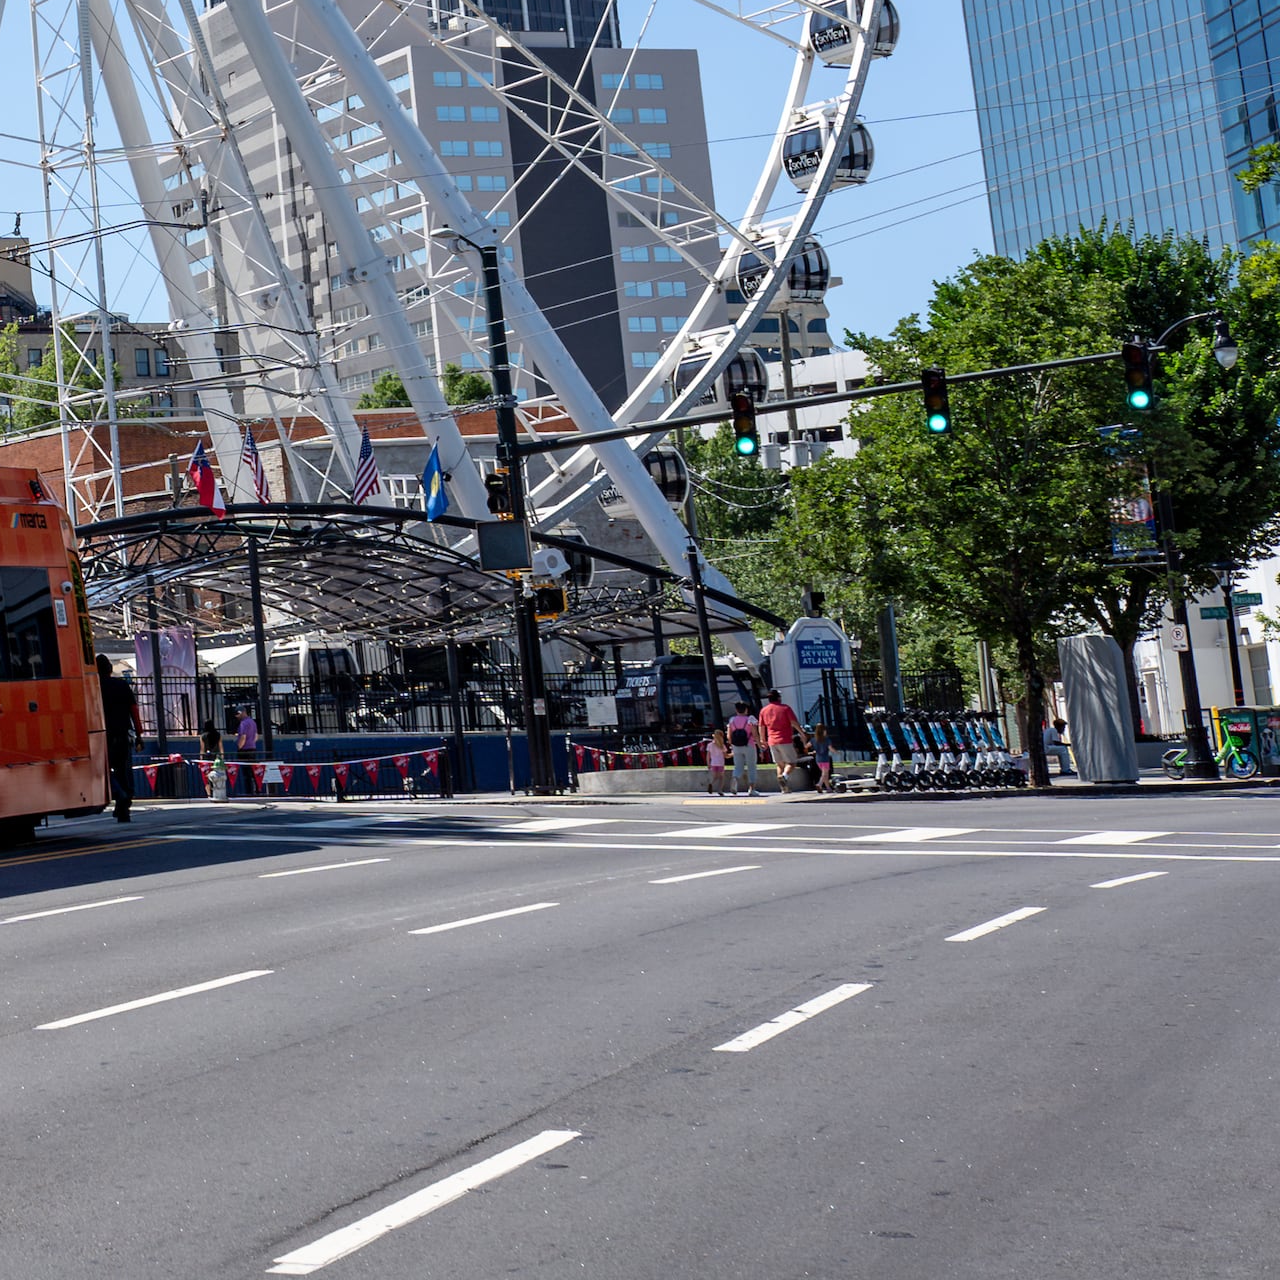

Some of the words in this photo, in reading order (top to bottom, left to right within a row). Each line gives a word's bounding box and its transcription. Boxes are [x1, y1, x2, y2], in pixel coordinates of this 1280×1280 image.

[818, 30, 844, 44] SKYVIEW
[792, 157, 818, 170] SKYVIEW
[19, 512, 47, 529] marta
[803, 657, 838, 665] ATLANTA
